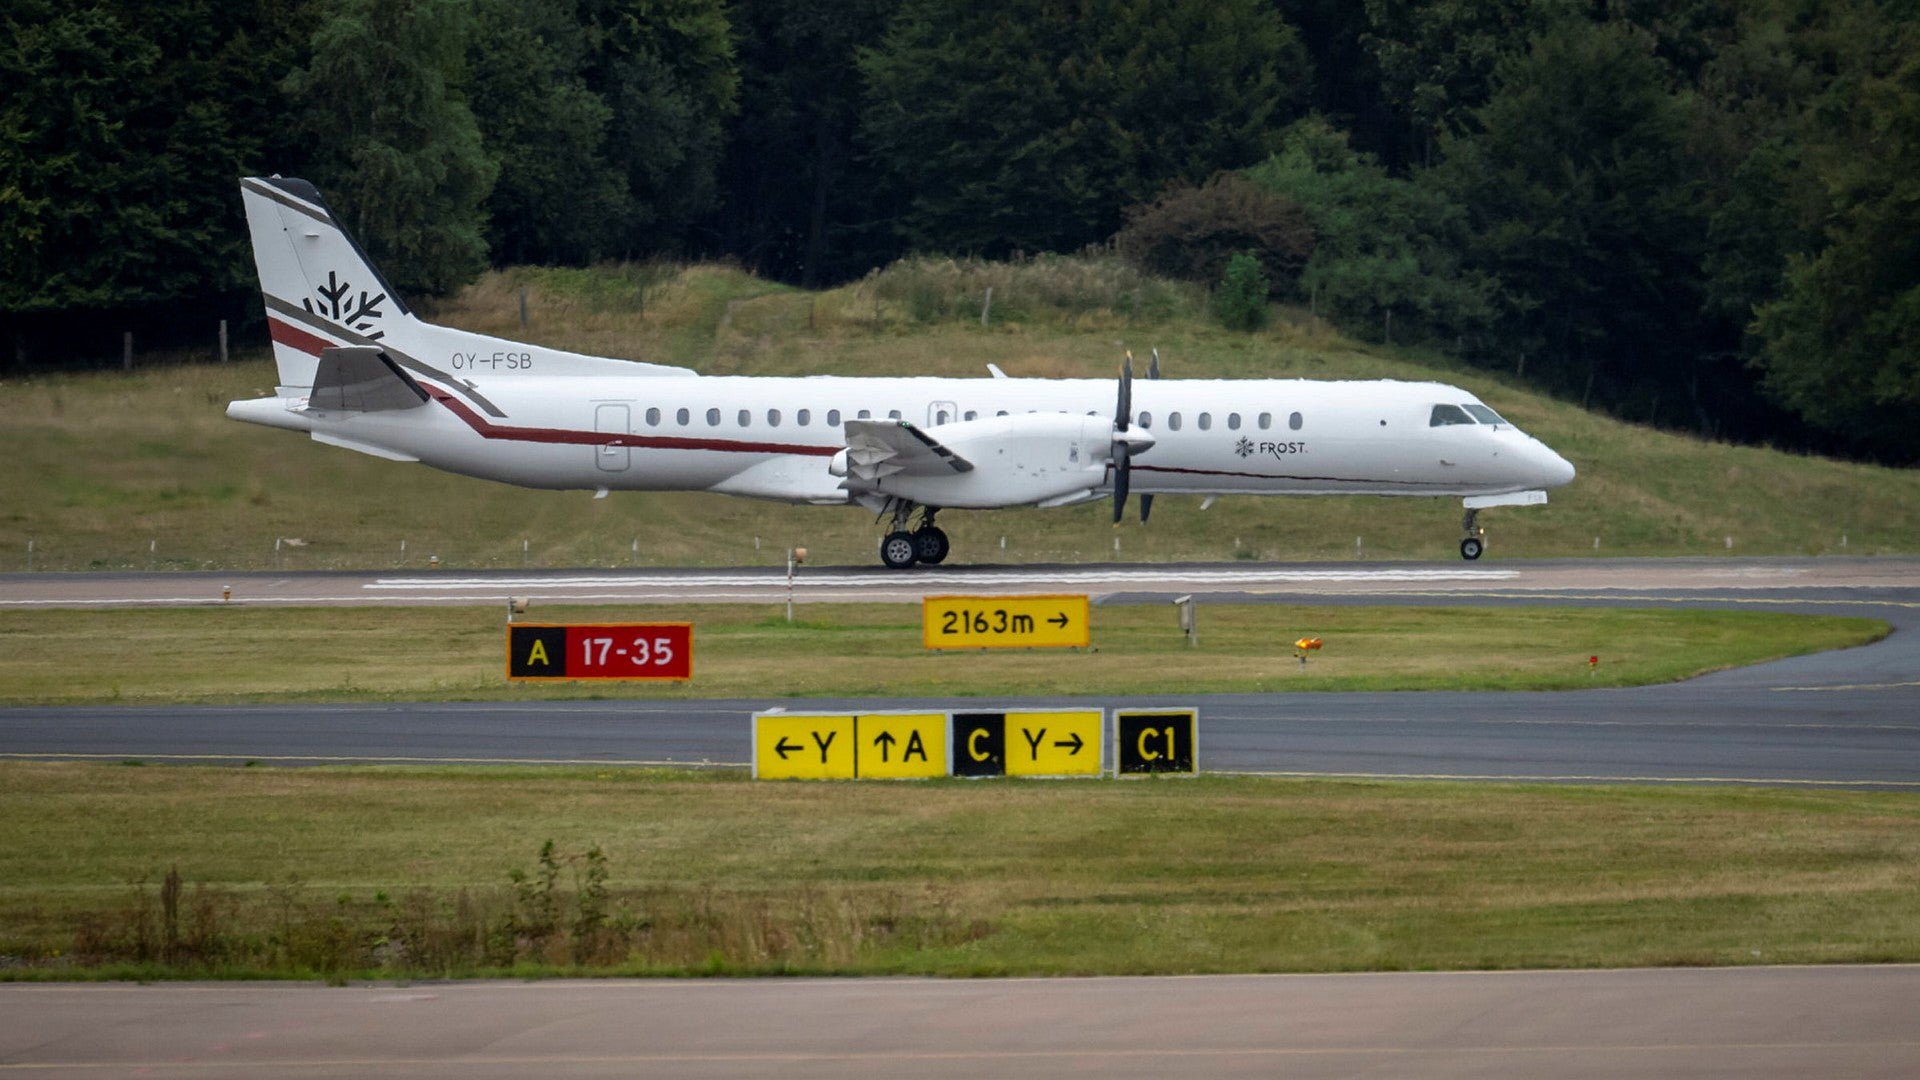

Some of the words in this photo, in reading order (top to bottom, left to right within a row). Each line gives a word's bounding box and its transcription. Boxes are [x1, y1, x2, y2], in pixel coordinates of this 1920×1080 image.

[452, 352, 532, 370] OY-FSB
[942, 609, 1034, 634] 2163m
[527, 638, 549, 666] A
[583, 638, 673, 666] 17-35
[812, 731, 837, 764] Y
[903, 729, 928, 763] A
[968, 728, 990, 762] C
[1022, 728, 1047, 761] Y
[1138, 727, 1175, 761] C1
